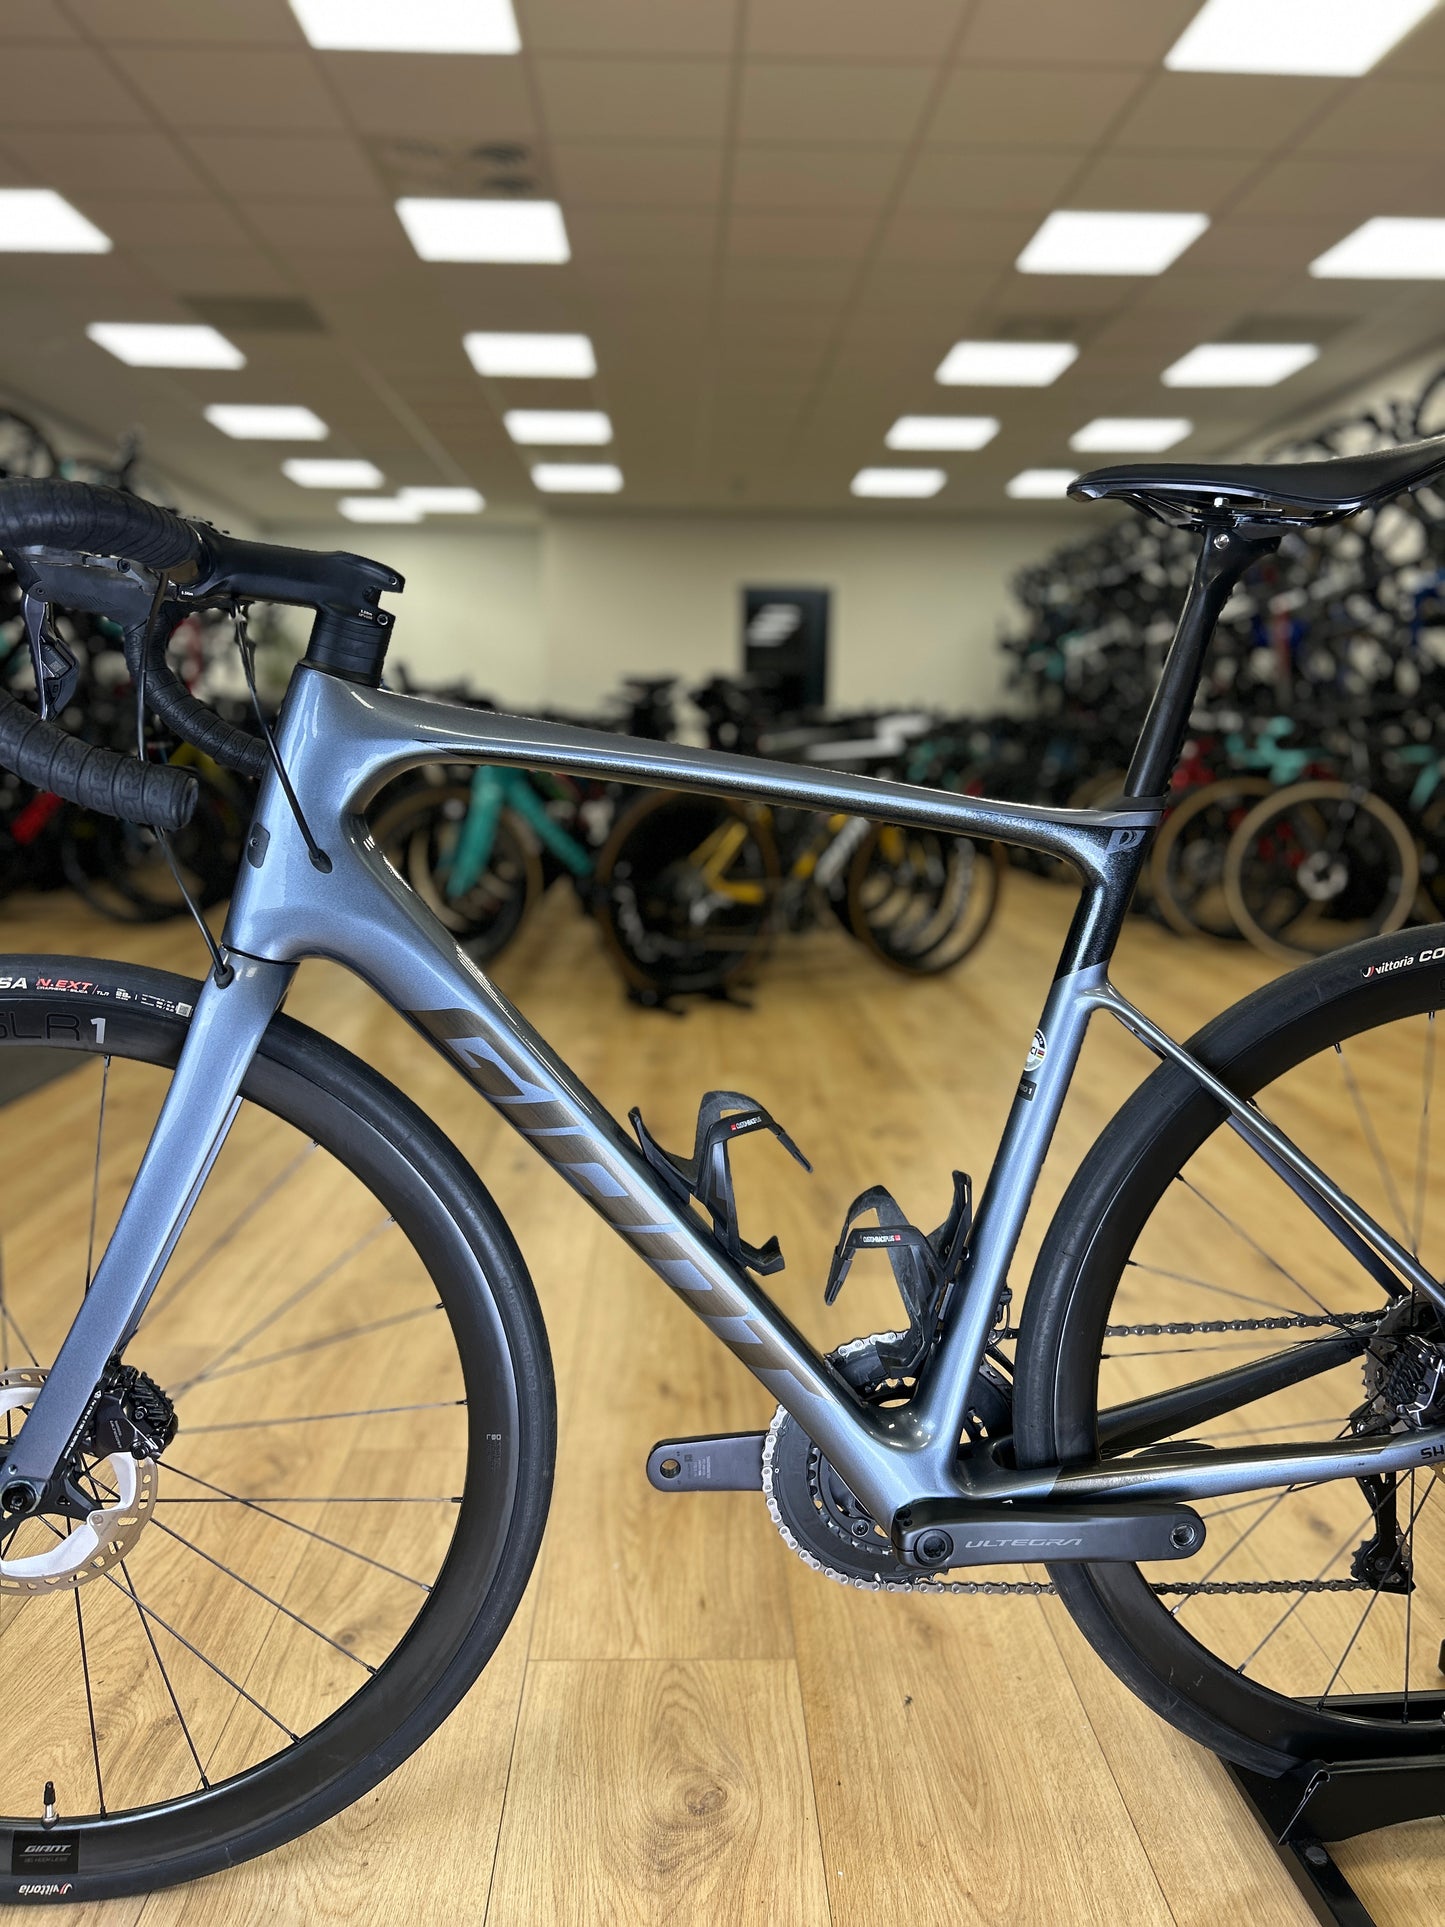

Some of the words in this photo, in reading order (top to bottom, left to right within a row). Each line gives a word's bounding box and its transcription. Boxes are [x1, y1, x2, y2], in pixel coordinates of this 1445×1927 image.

[1375, 956, 1414, 974] vittoria
[1419, 947, 1445, 962] CO
[0, 1010, 81, 1042] LR
[90, 1017, 106, 1045] 1
[1420, 1444, 1445, 1460] SH
[965, 1538, 1083, 1549] ULTEGRA
[24, 1845, 72, 1853] GIANT
[19, 1885, 60, 1896] vittoria
